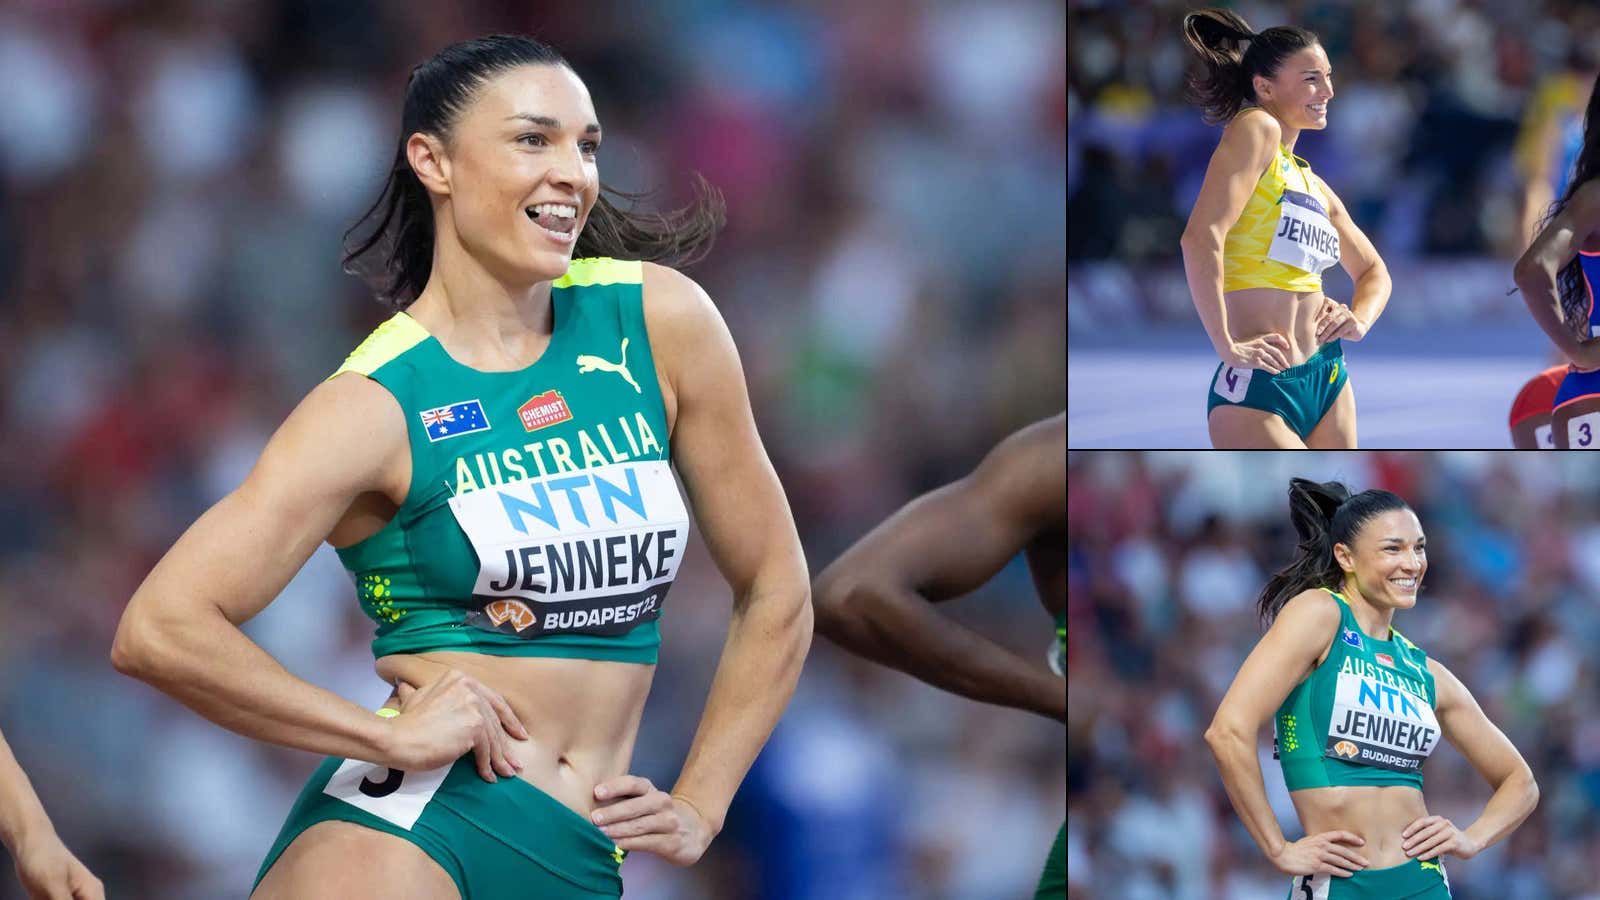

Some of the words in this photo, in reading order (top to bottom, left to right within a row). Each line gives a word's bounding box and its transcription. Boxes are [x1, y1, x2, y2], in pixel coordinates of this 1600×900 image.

[1278, 215, 1339, 260] JENNEKE
[522, 400, 564, 422] CHEMIST
[455, 411, 662, 497] AUSTRALIA
[1578, 422, 1593, 447] 3
[497, 467, 649, 536] NTN
[489, 529, 678, 595] JENNEKE
[1341, 655, 1428, 702] AUSTRALIA
[1358, 678, 1423, 721] NTN
[1336, 709, 1436, 753] JENNEKE
[1300, 874, 1314, 900] 5
